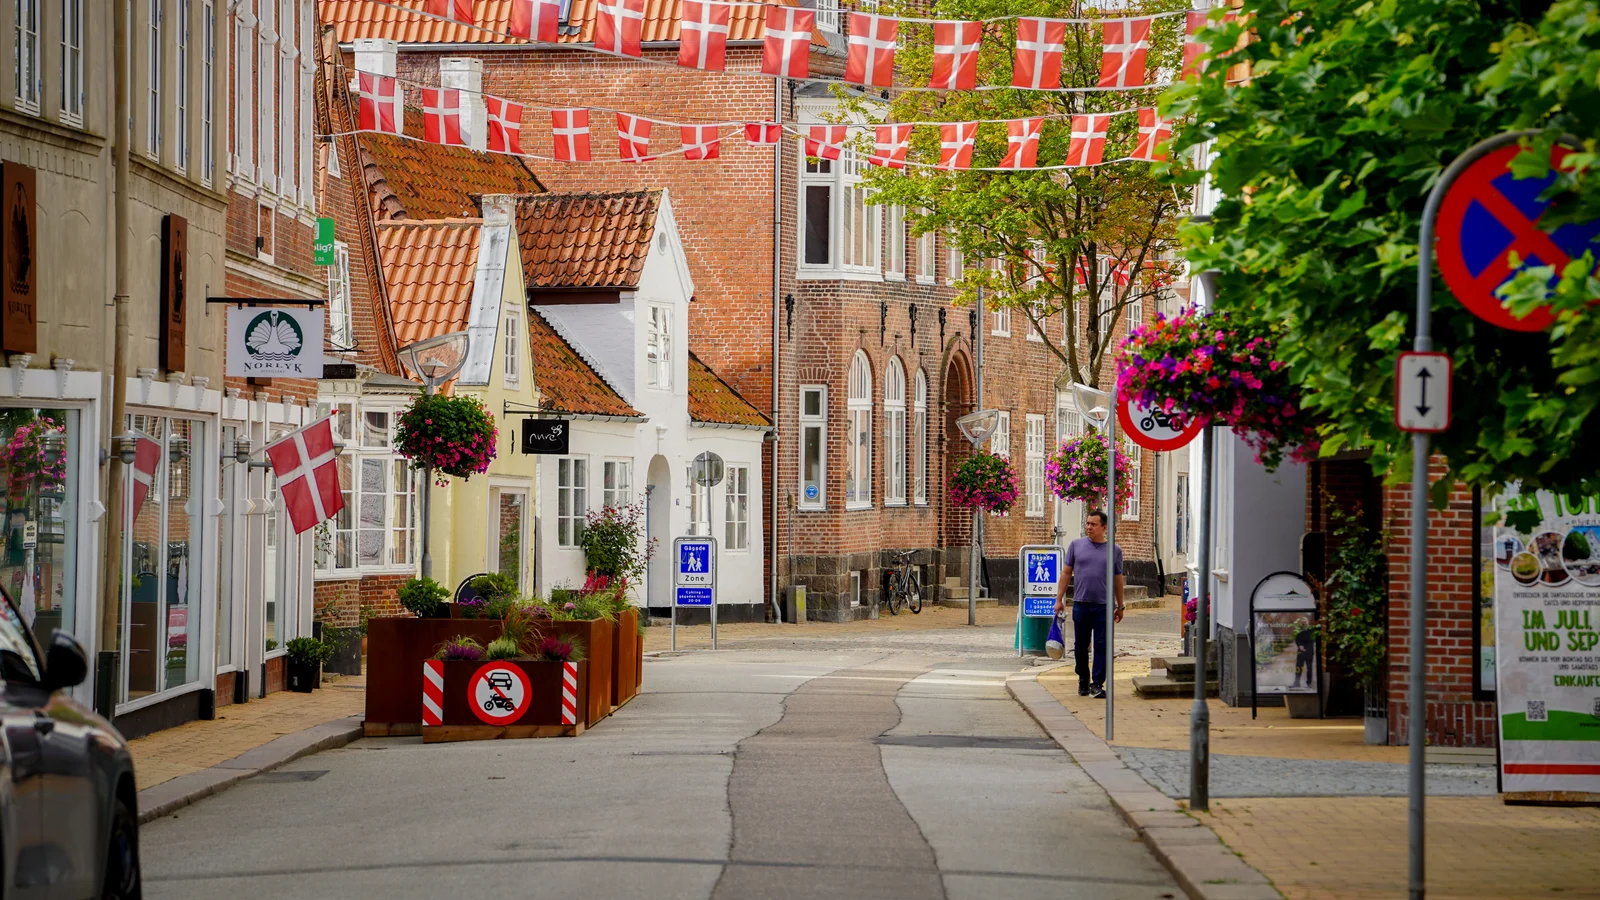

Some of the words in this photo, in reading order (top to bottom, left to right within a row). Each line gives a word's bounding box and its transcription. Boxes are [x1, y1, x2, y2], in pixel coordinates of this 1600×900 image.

[244, 362, 302, 373] NORLYK
[1522, 609, 1546, 630] IM
[1524, 631, 1560, 652] UND
[1567, 631, 1600, 652] SEP
